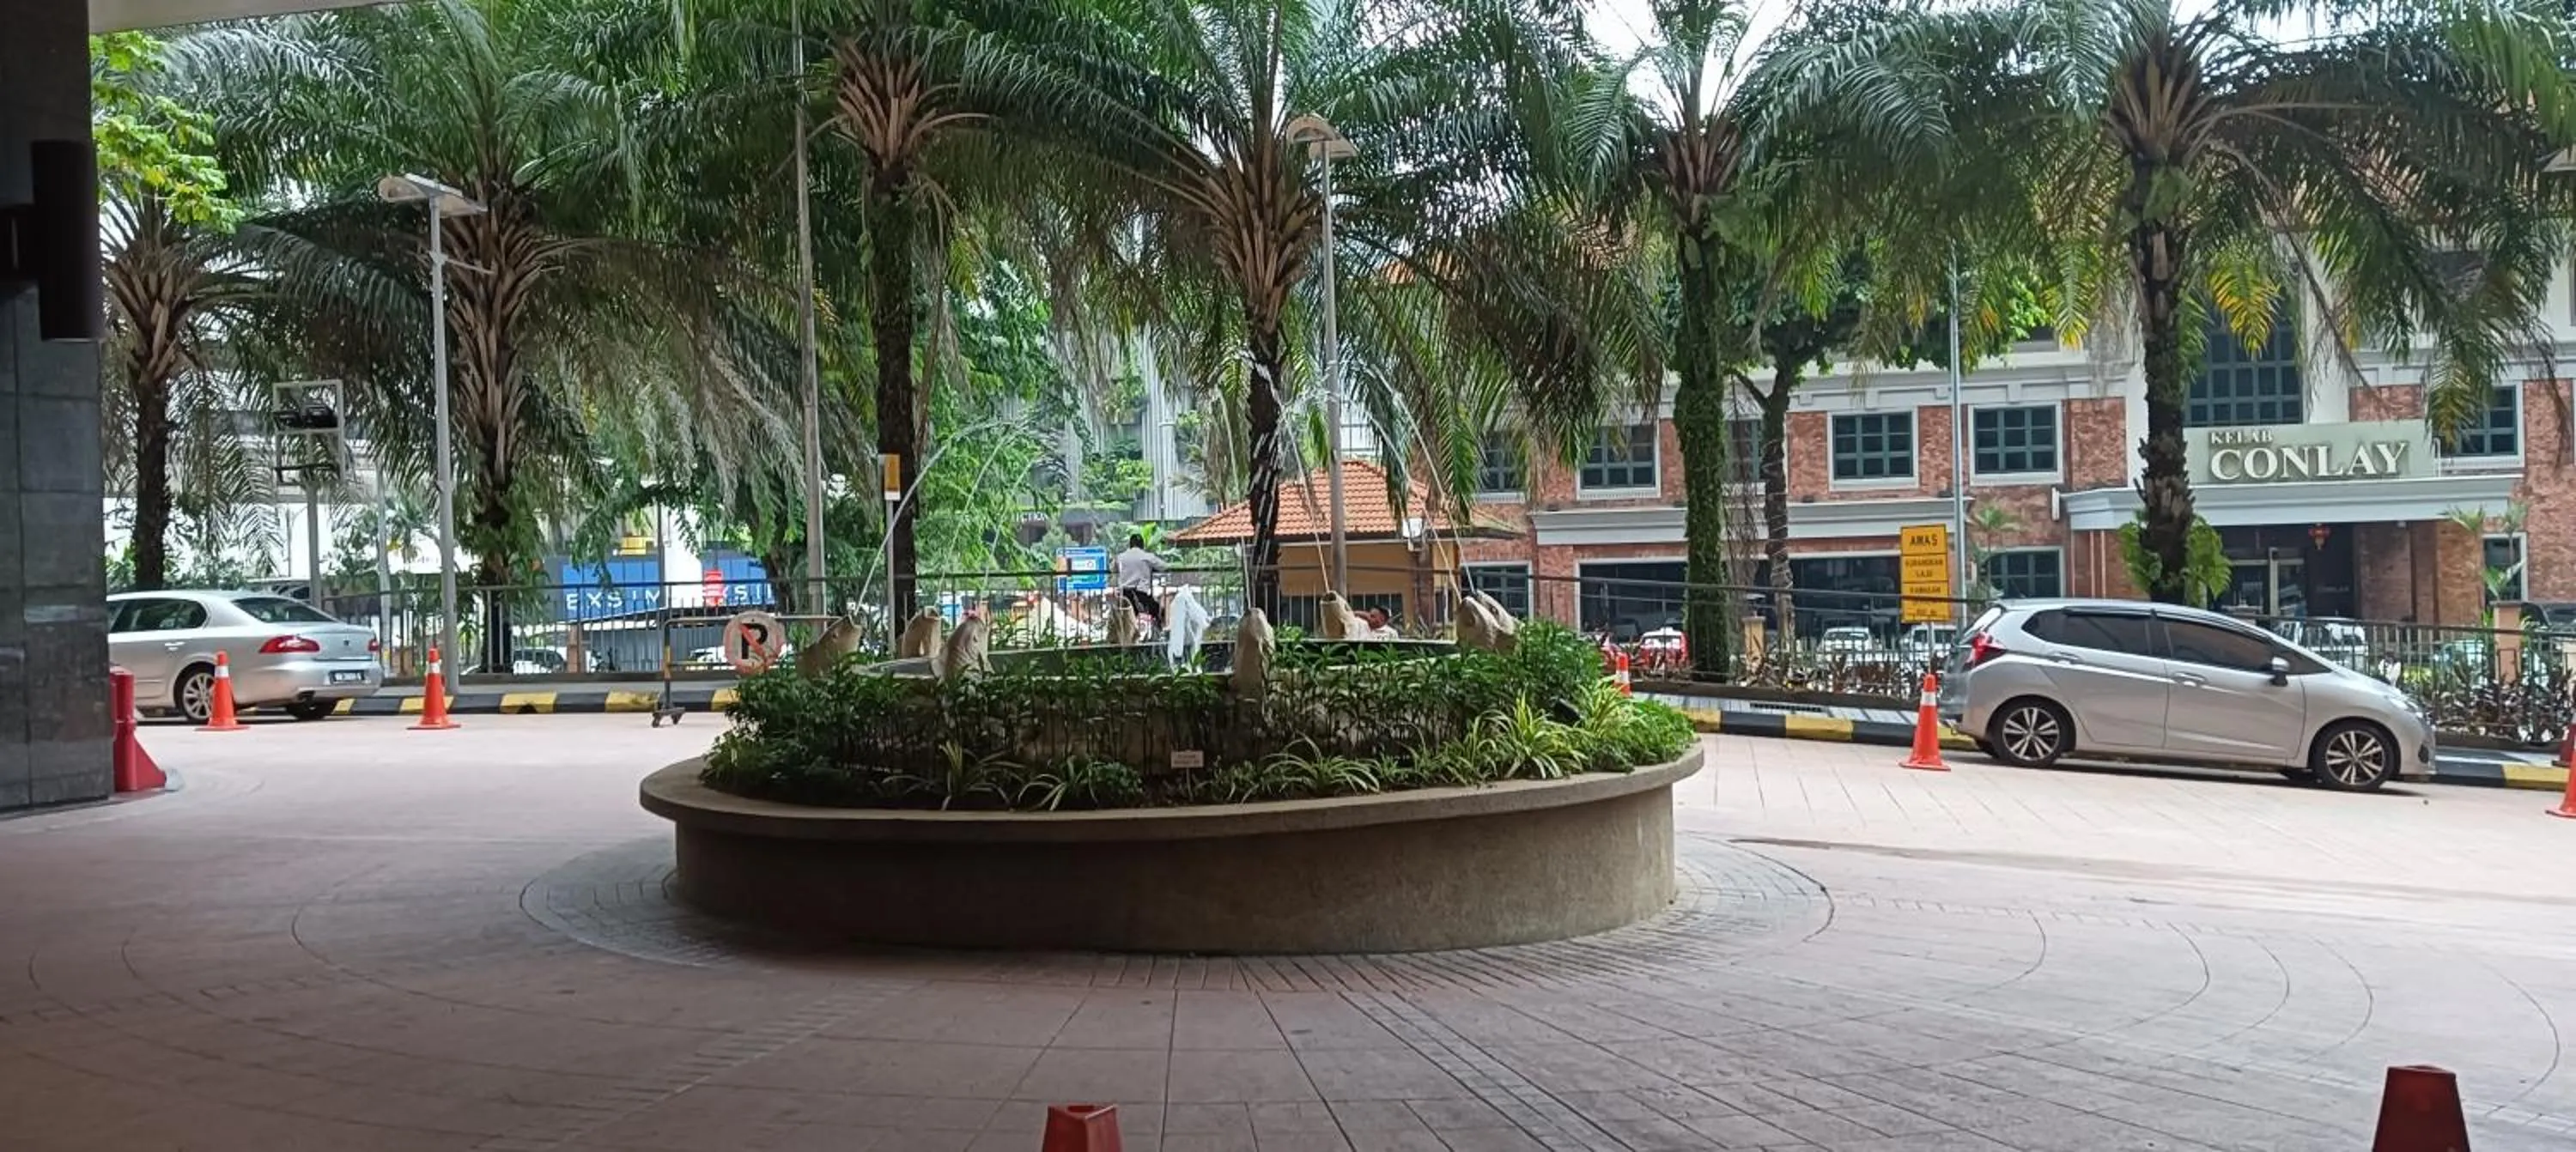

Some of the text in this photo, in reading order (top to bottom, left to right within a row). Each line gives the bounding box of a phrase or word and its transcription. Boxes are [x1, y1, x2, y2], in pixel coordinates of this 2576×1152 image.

[2210, 430, 2273, 445] KELAB
[2210, 441, 2408, 481] CONLAY
[1909, 533, 1938, 547] AWAS
[565, 588, 660, 611] EXSIM
[741, 622, 769, 660] P
